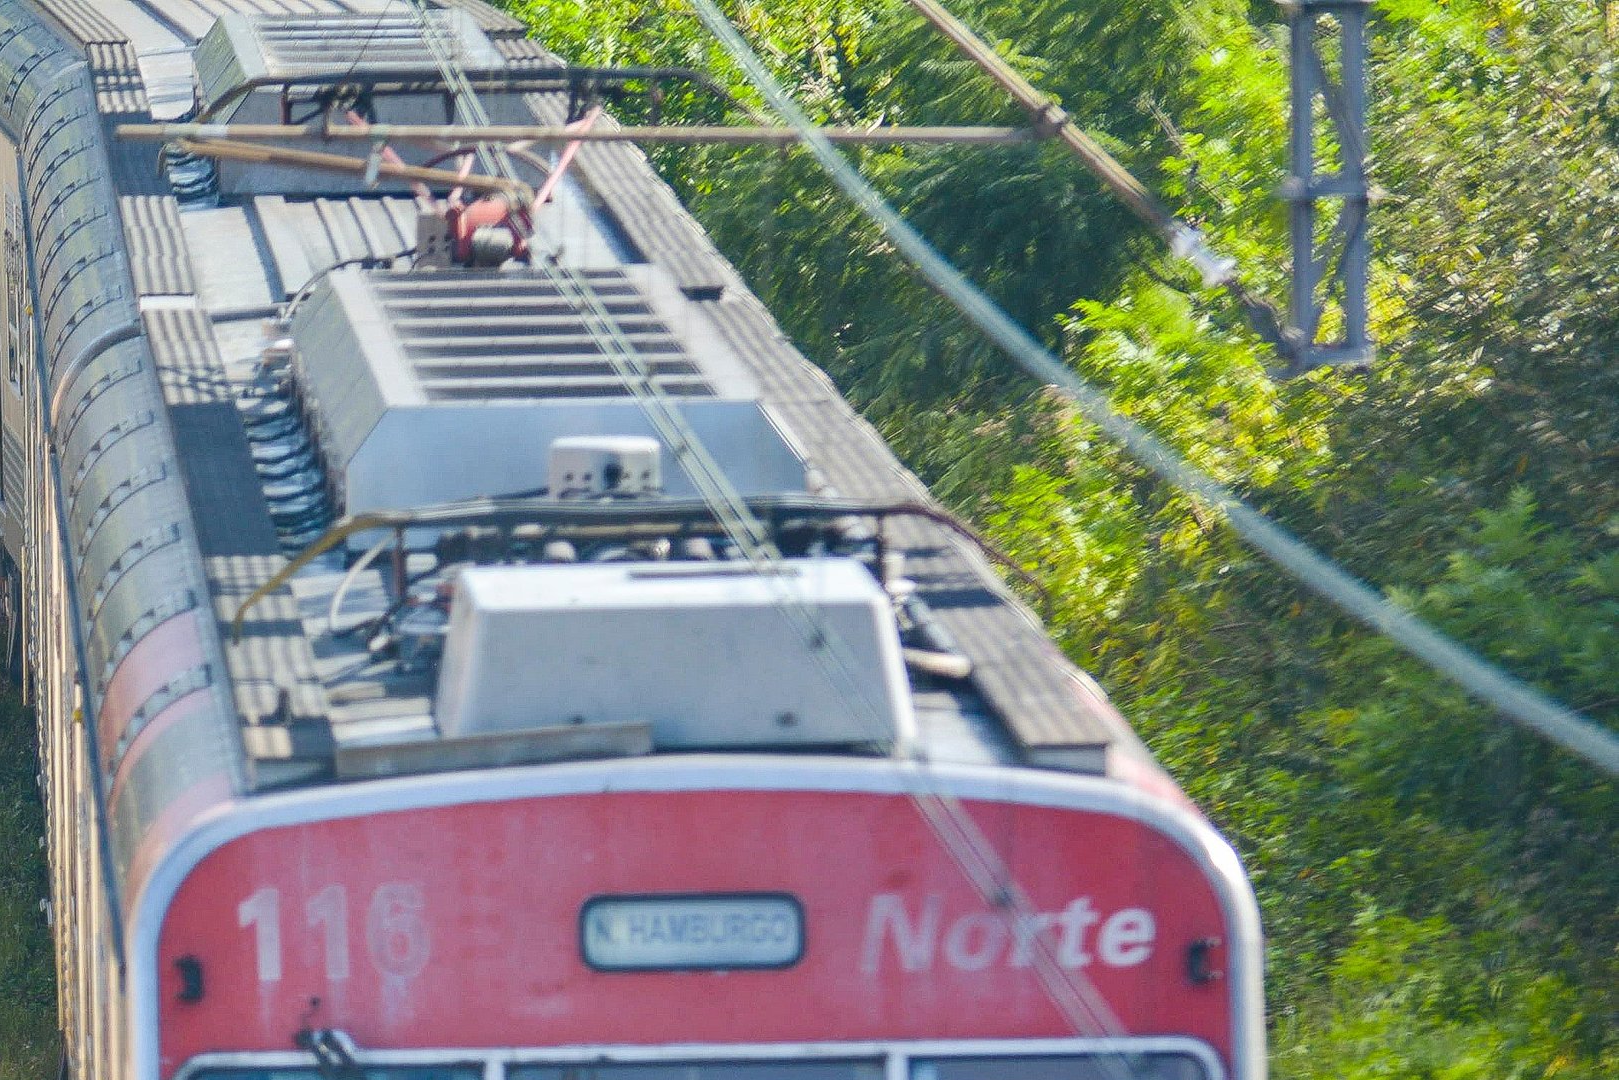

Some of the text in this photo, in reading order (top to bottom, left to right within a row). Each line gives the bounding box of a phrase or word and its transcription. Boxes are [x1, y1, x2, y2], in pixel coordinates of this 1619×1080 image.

[238, 883, 430, 981] 116
[629, 912, 790, 944] HAMBURGO
[861, 893, 1158, 973] Norte
